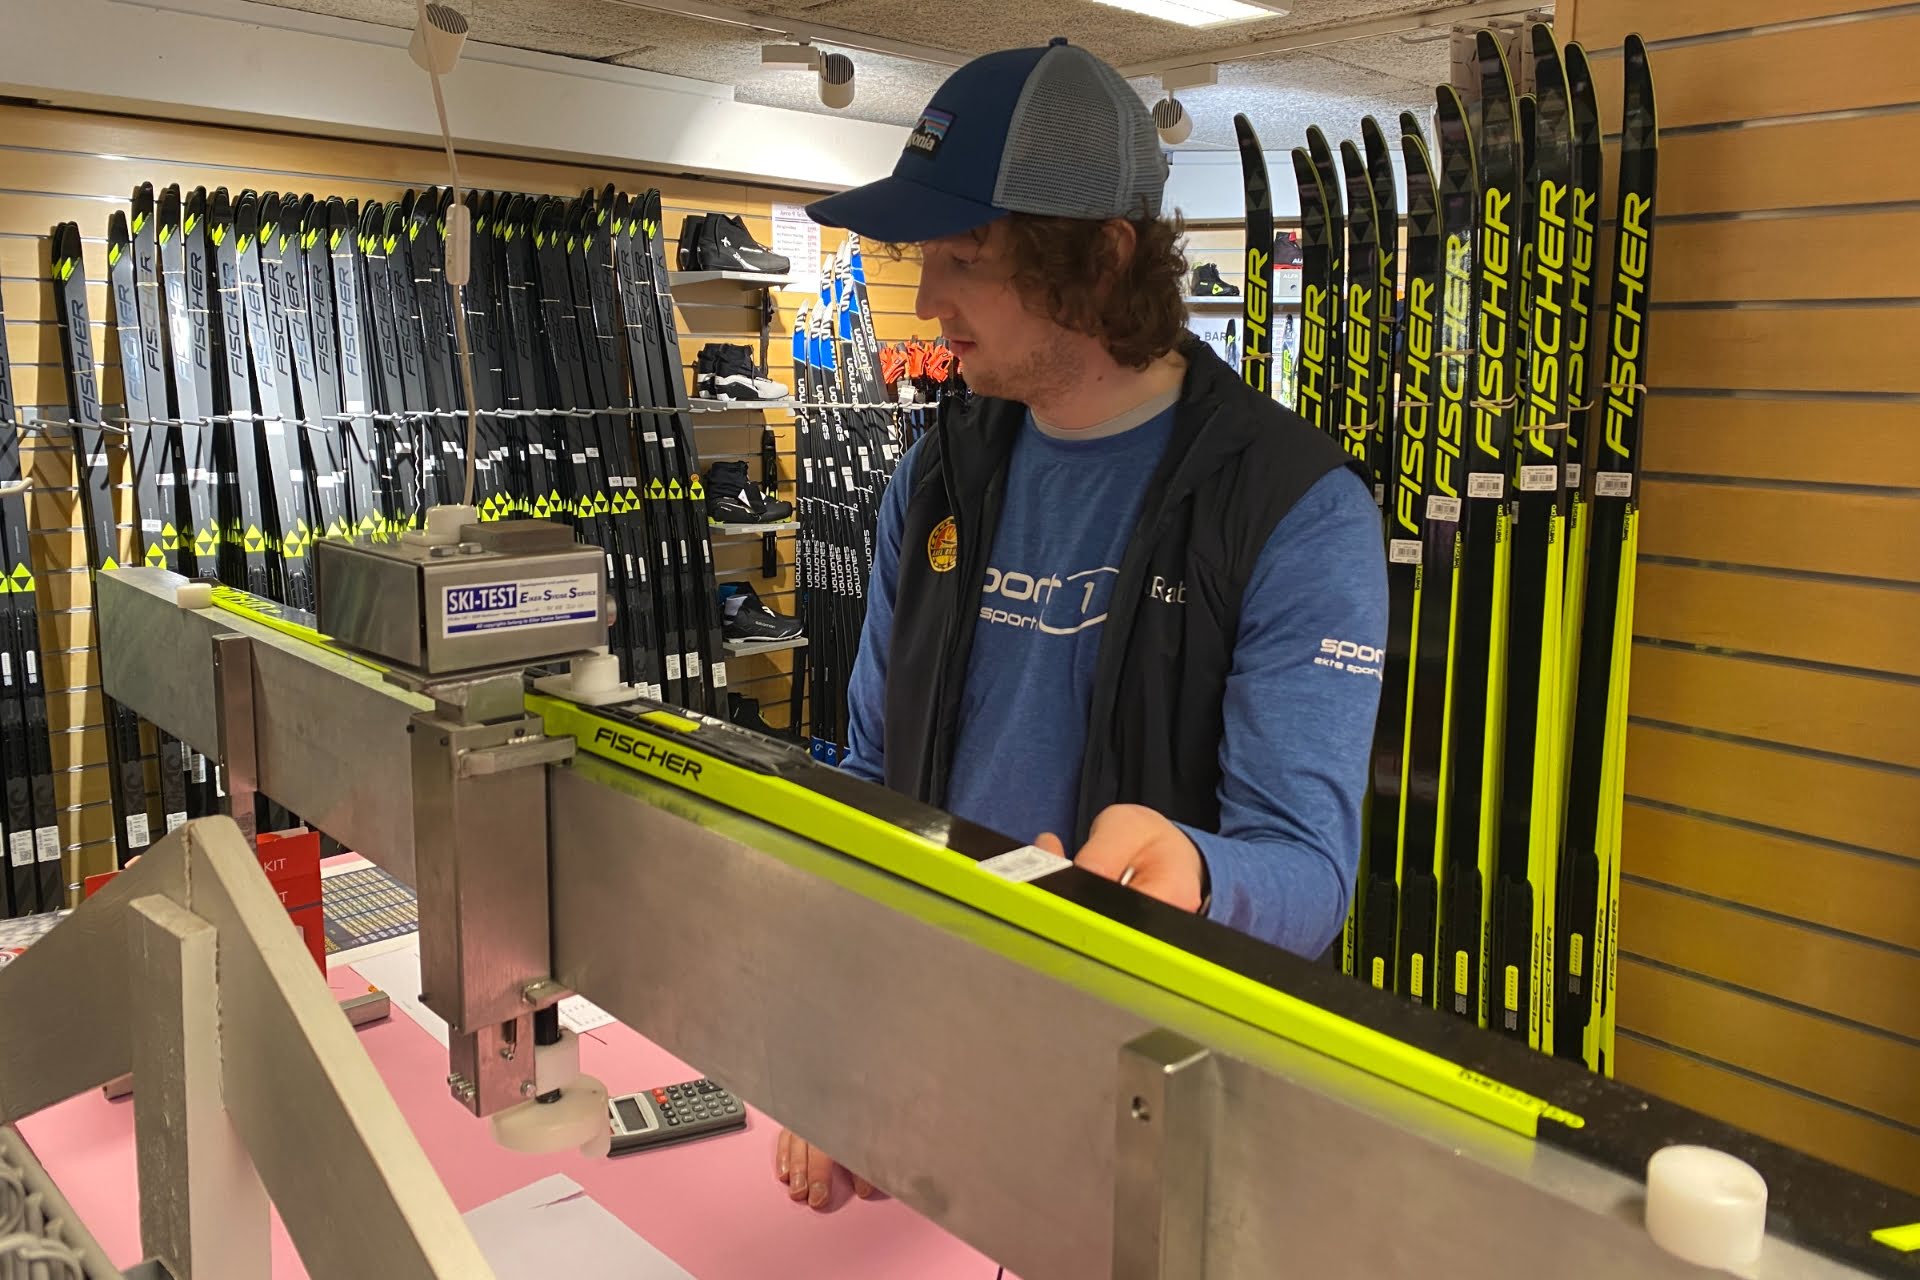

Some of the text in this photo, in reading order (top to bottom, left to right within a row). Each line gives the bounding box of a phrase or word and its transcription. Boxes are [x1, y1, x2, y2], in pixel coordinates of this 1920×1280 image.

[192, 252, 208, 371] FISCHER
[222, 262, 244, 378] FISCHER
[246, 274, 273, 388] FISCHER
[268, 262, 288, 376] FISCHER
[285, 272, 312, 382] FISCHER
[313, 264, 334, 375] FISCHER
[338, 267, 357, 376] FISCHER
[375, 271, 397, 378] FISCHER
[394, 270, 416, 376] FISCHER
[622, 250, 641, 344] FISCHER
[656, 253, 677, 346] FISCHER
[1245, 247, 1268, 392] CHER
[1476, 187, 1510, 459] FISCHER
[1529, 180, 1566, 458] FISCHER
[1567, 187, 1595, 448] ISCHER
[1606, 192, 1650, 458] FISCHER
[71, 299, 98, 423] FISCHER
[1301, 284, 1326, 428] CHER
[1345, 284, 1371, 461] CHER
[1397, 277, 1434, 535] FISCHER
[1435, 234, 1470, 498] FISCHER
[448, 587, 516, 612] SKI-TEST
[568, 587, 596, 599] SERVICE
[1081, 581, 1095, 614] 1
[1320, 638, 1384, 663] spor
[594, 727, 703, 782] FISCHER
[264, 858, 287, 873] KIT
[1482, 920, 1490, 1019] FISCHER
[1532, 932, 1540, 1032] FISCHER
[1595, 908, 1604, 1003] FISCHER
